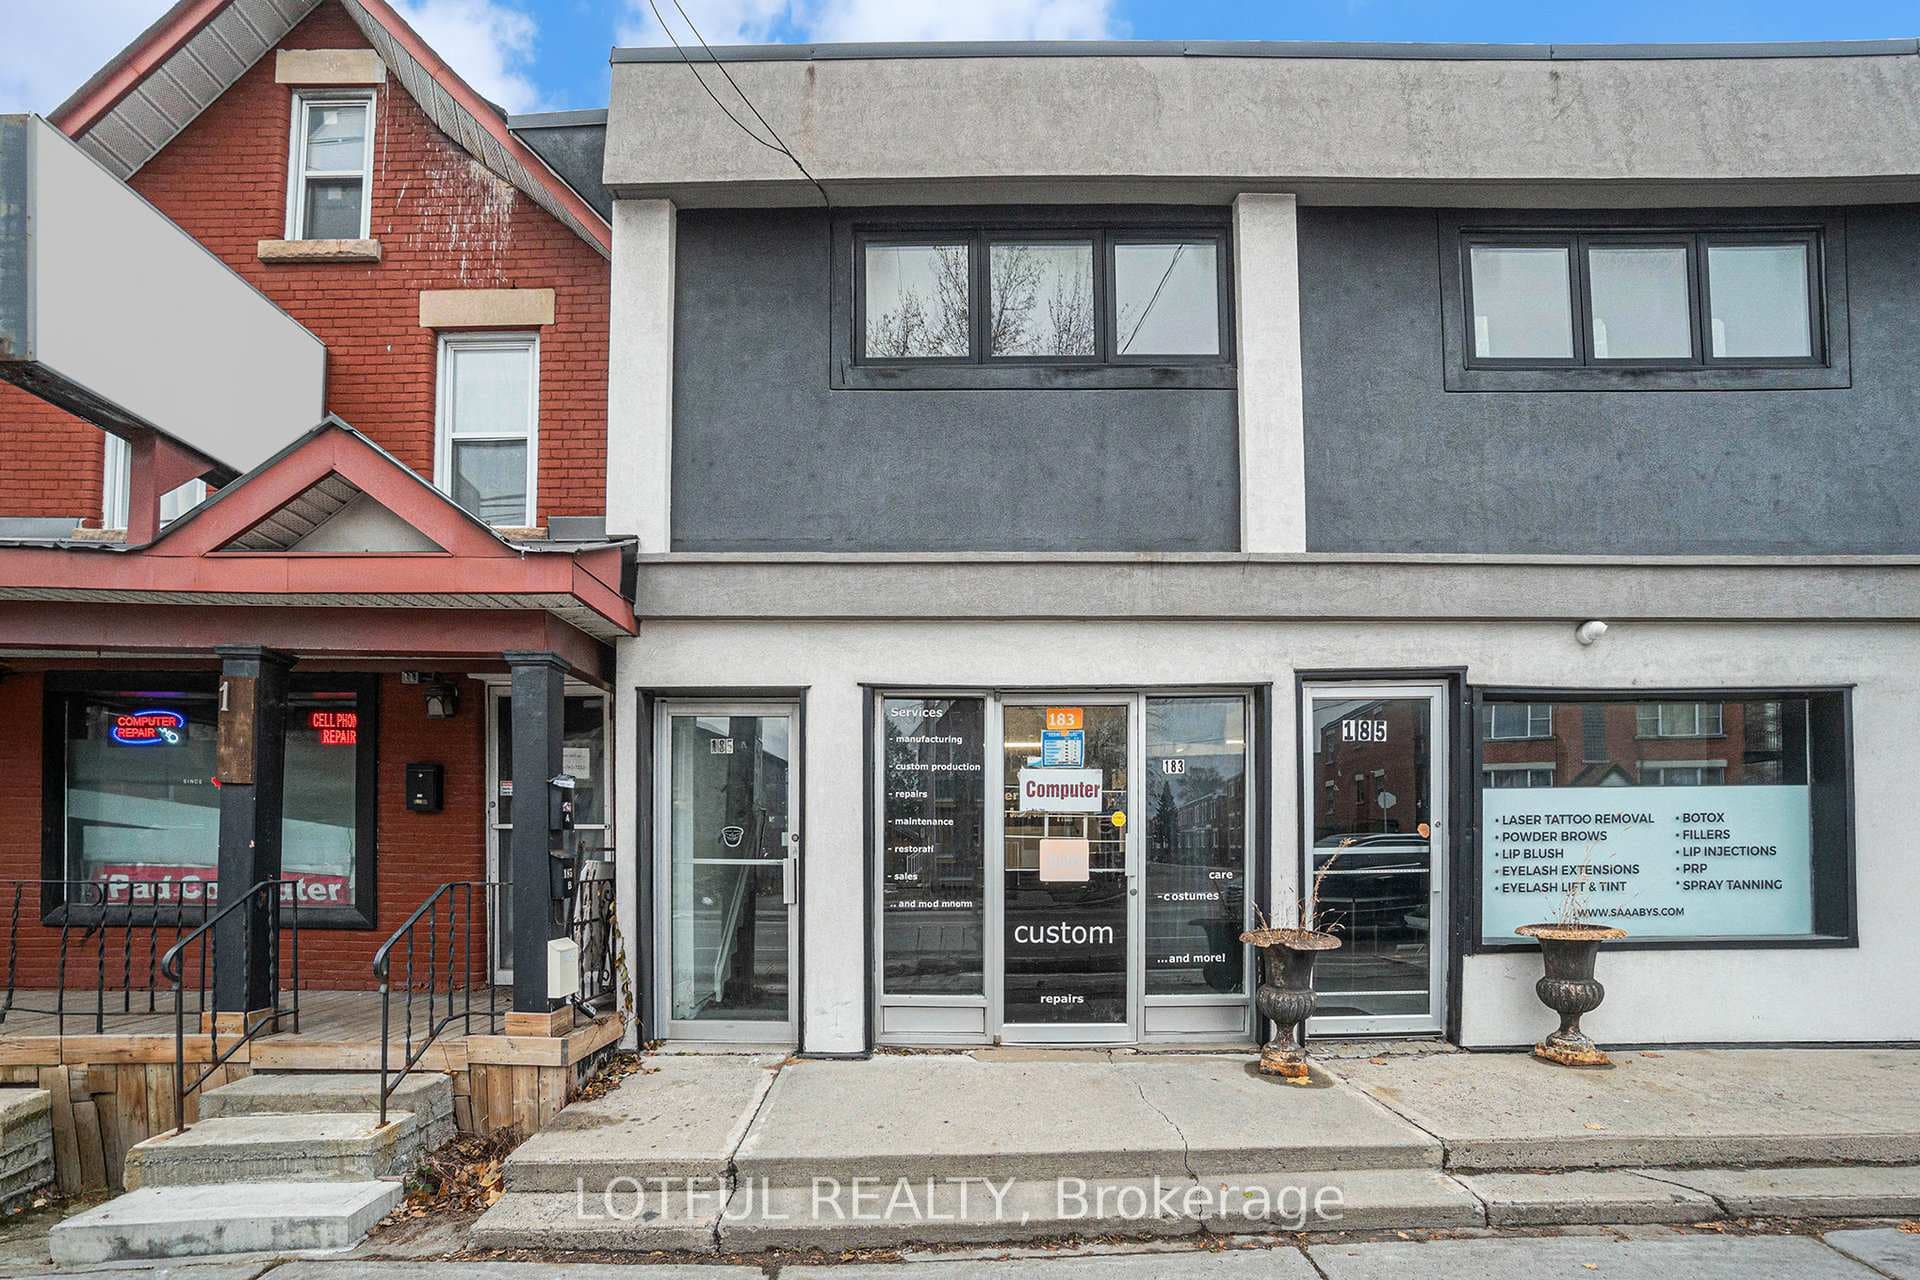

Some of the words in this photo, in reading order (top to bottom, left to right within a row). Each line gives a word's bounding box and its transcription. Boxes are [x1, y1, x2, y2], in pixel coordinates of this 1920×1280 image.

[891, 707, 943, 718] Services
[117, 716, 177, 727] COMPUTER
[313, 713, 336, 728] CELL
[1049, 713, 1075, 727] 183
[117, 727, 156, 738] REPAIR
[1343, 720, 1386, 741] 185
[323, 729, 357, 744] REPAIR
[896, 735, 963, 745] manufacturing
[895, 763, 929, 771] custom
[931, 762, 981, 772] production
[1164, 760, 1184, 773] 183
[895, 790, 928, 799] repairs
[1026, 780, 1101, 800] Computer
[894, 817, 954, 826] maintenance
[1502, 814, 1542, 826] LASER
[1544, 813, 1592, 825] TATTOO
[1594, 812, 1655, 825] REMOVAL
[1682, 812, 1725, 823] BOTOX
[1502, 831, 1558, 842] POWDER
[1560, 830, 1608, 842] BROWS
[1682, 829, 1731, 840] FILLERS
[1502, 848, 1521, 859] LIP
[1523, 848, 1564, 859] BLUSH
[1682, 846, 1701, 857] LIP
[1703, 845, 1777, 857] INJECTIONS
[1502, 865, 1558, 876] EYELASH
[1561, 863, 1640, 875] EXTENSIONS
[1682, 863, 1708, 874] PRP
[894, 872, 918, 880] sales
[1208, 870, 1233, 879] care
[1502, 882, 1558, 893] EYELASH
[1588, 881, 1597, 892] &
[1600, 881, 1627, 892] TINT
[1682, 880, 1724, 891] SPRAY
[1726, 879, 1783, 891] TANNING
[1576, 906, 1685, 918] WWW.SAAABYS.COM
[1014, 921, 1114, 944] custom
[1193, 953, 1226, 963] more!
[1040, 994, 1085, 1005] repairs
